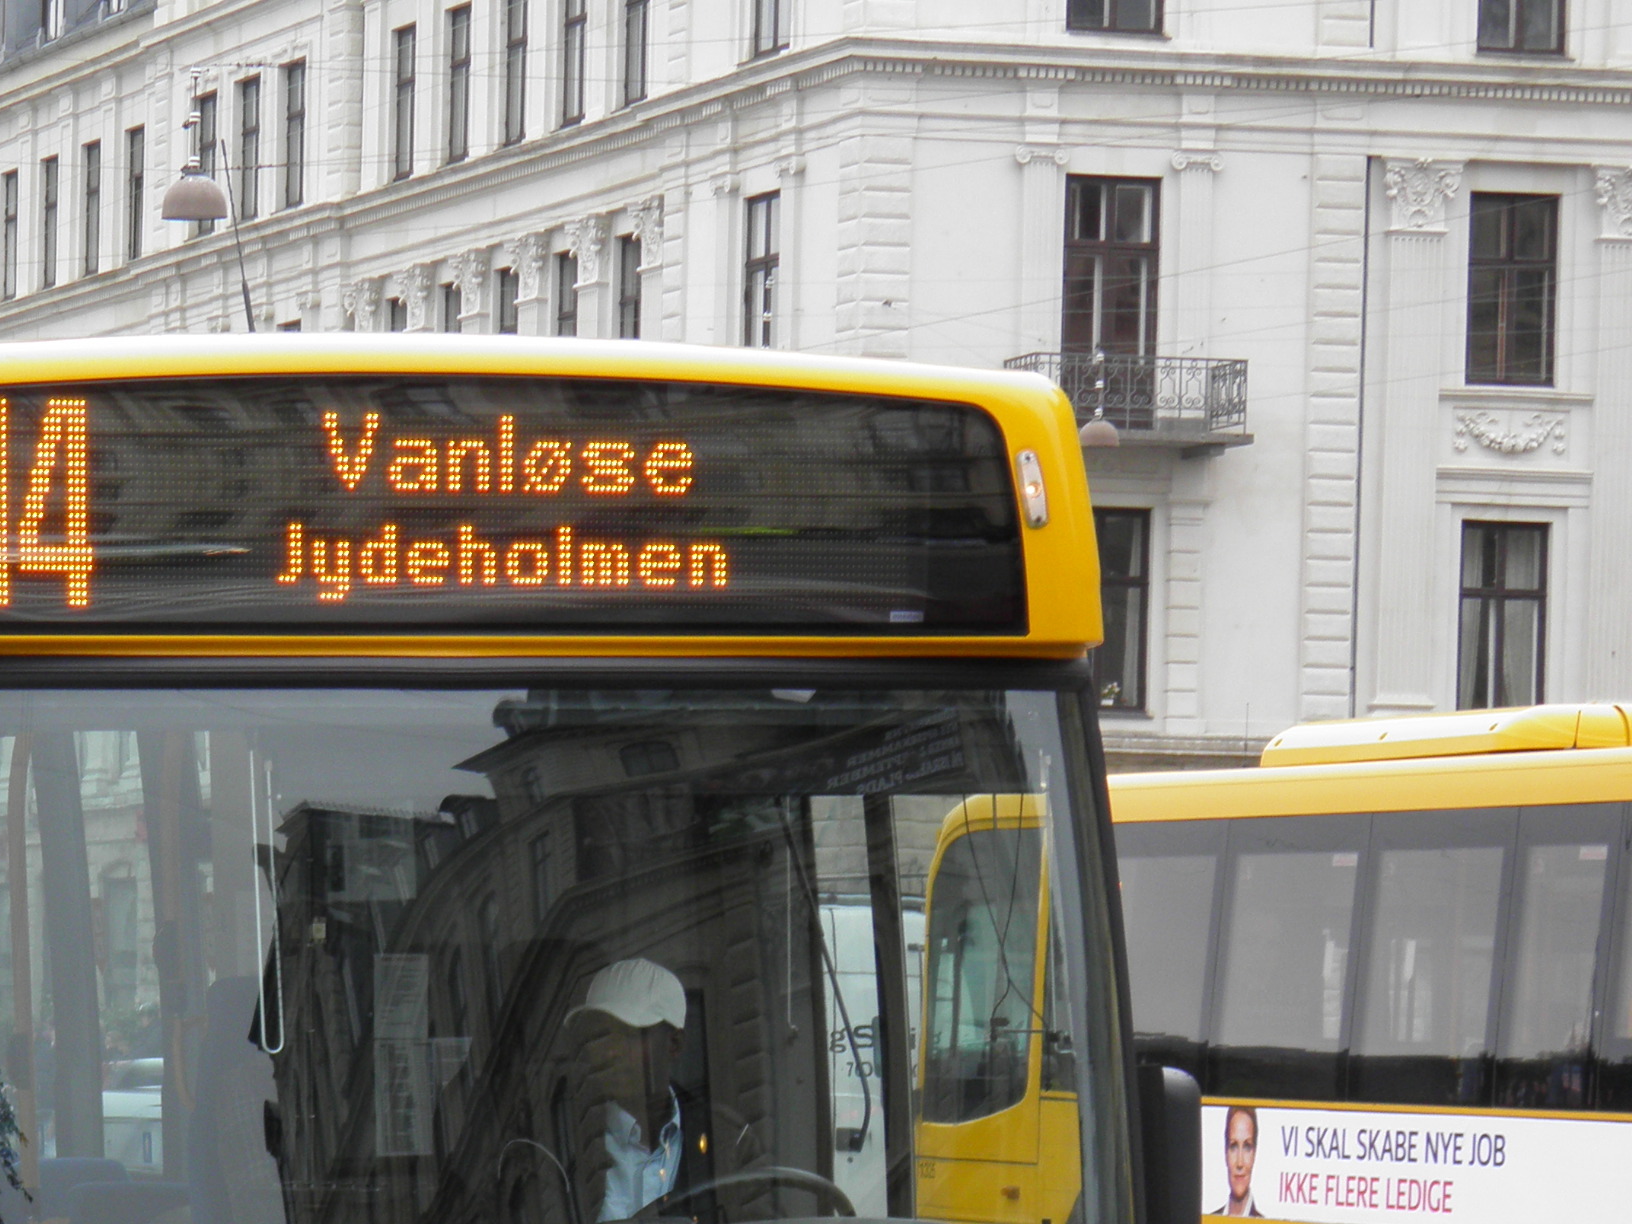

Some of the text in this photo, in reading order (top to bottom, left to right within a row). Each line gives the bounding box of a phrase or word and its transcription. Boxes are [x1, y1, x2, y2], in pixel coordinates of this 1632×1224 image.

[323, 411, 694, 496] Vanløse
[273, 521, 728, 602] Jydeholmen
[1281, 1125, 1506, 1167] VI SKAL SKABE NYE JOB
[1279, 1172, 1454, 1213] IKKE FLERE LEDIGE
